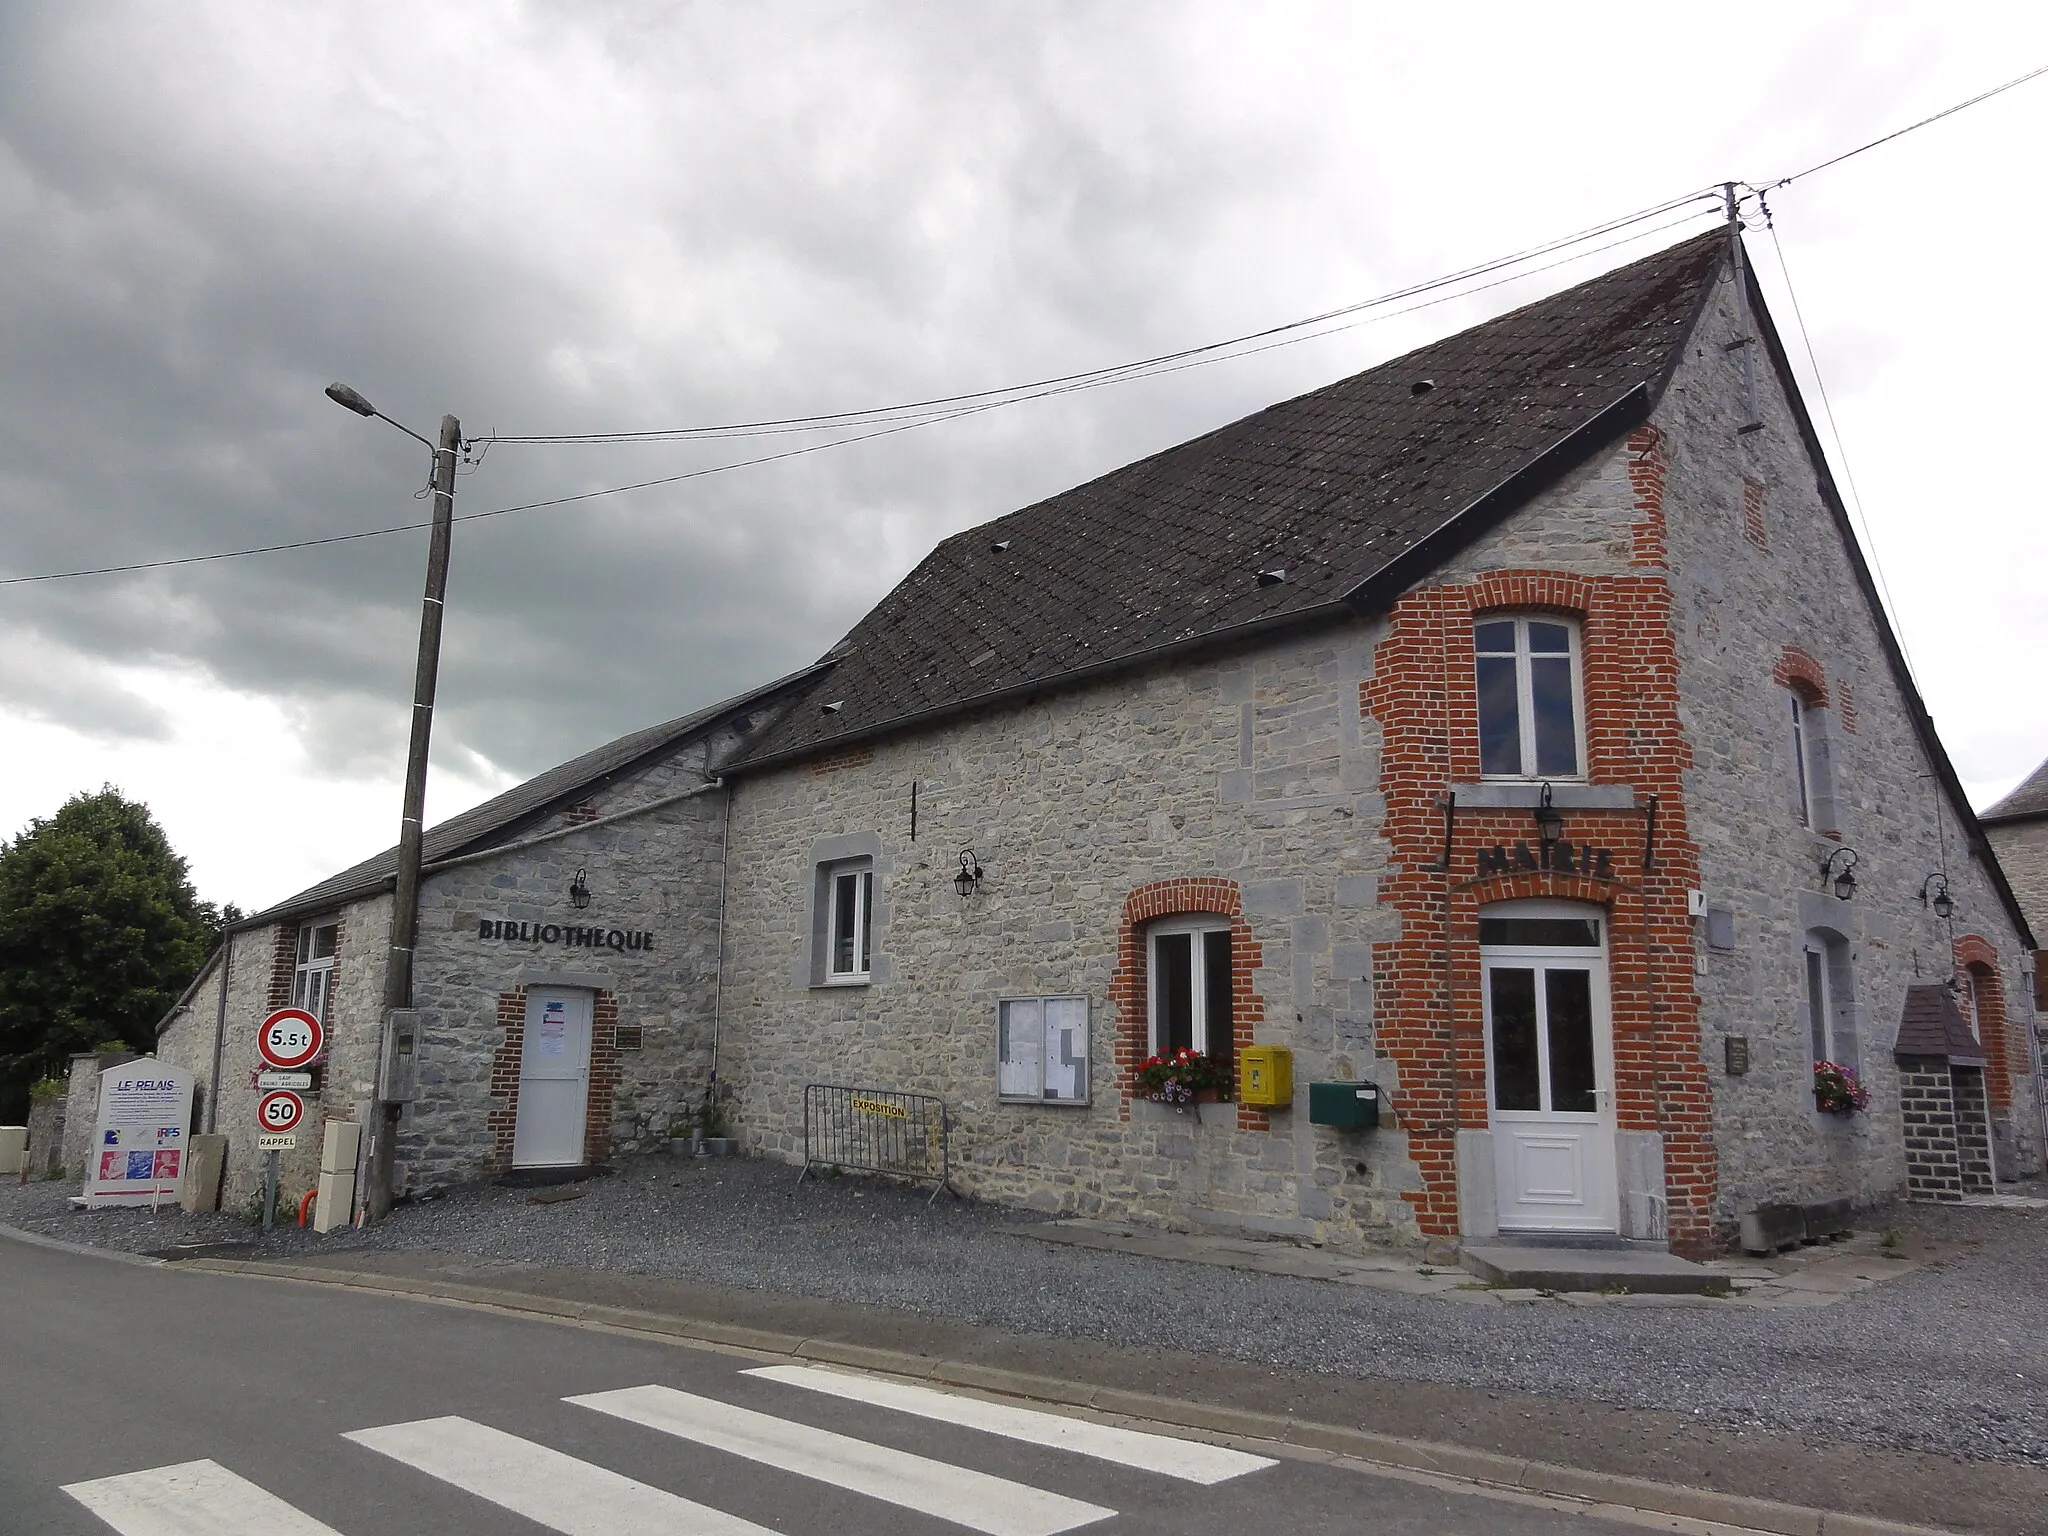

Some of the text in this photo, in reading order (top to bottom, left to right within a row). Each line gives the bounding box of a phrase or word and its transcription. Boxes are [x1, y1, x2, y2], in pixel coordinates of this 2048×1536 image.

[1477, 842, 1615, 879] MAIRIE
[479, 919, 654, 952] BIBLIOTHEQUE
[270, 1029, 308, 1046] 5.5 t
[117, 1080, 175, 1091] LE RELAIS
[268, 1103, 294, 1120] 50
[853, 1099, 905, 1117] EXPOSITION
[259, 1137, 295, 1146] RAPPEL
